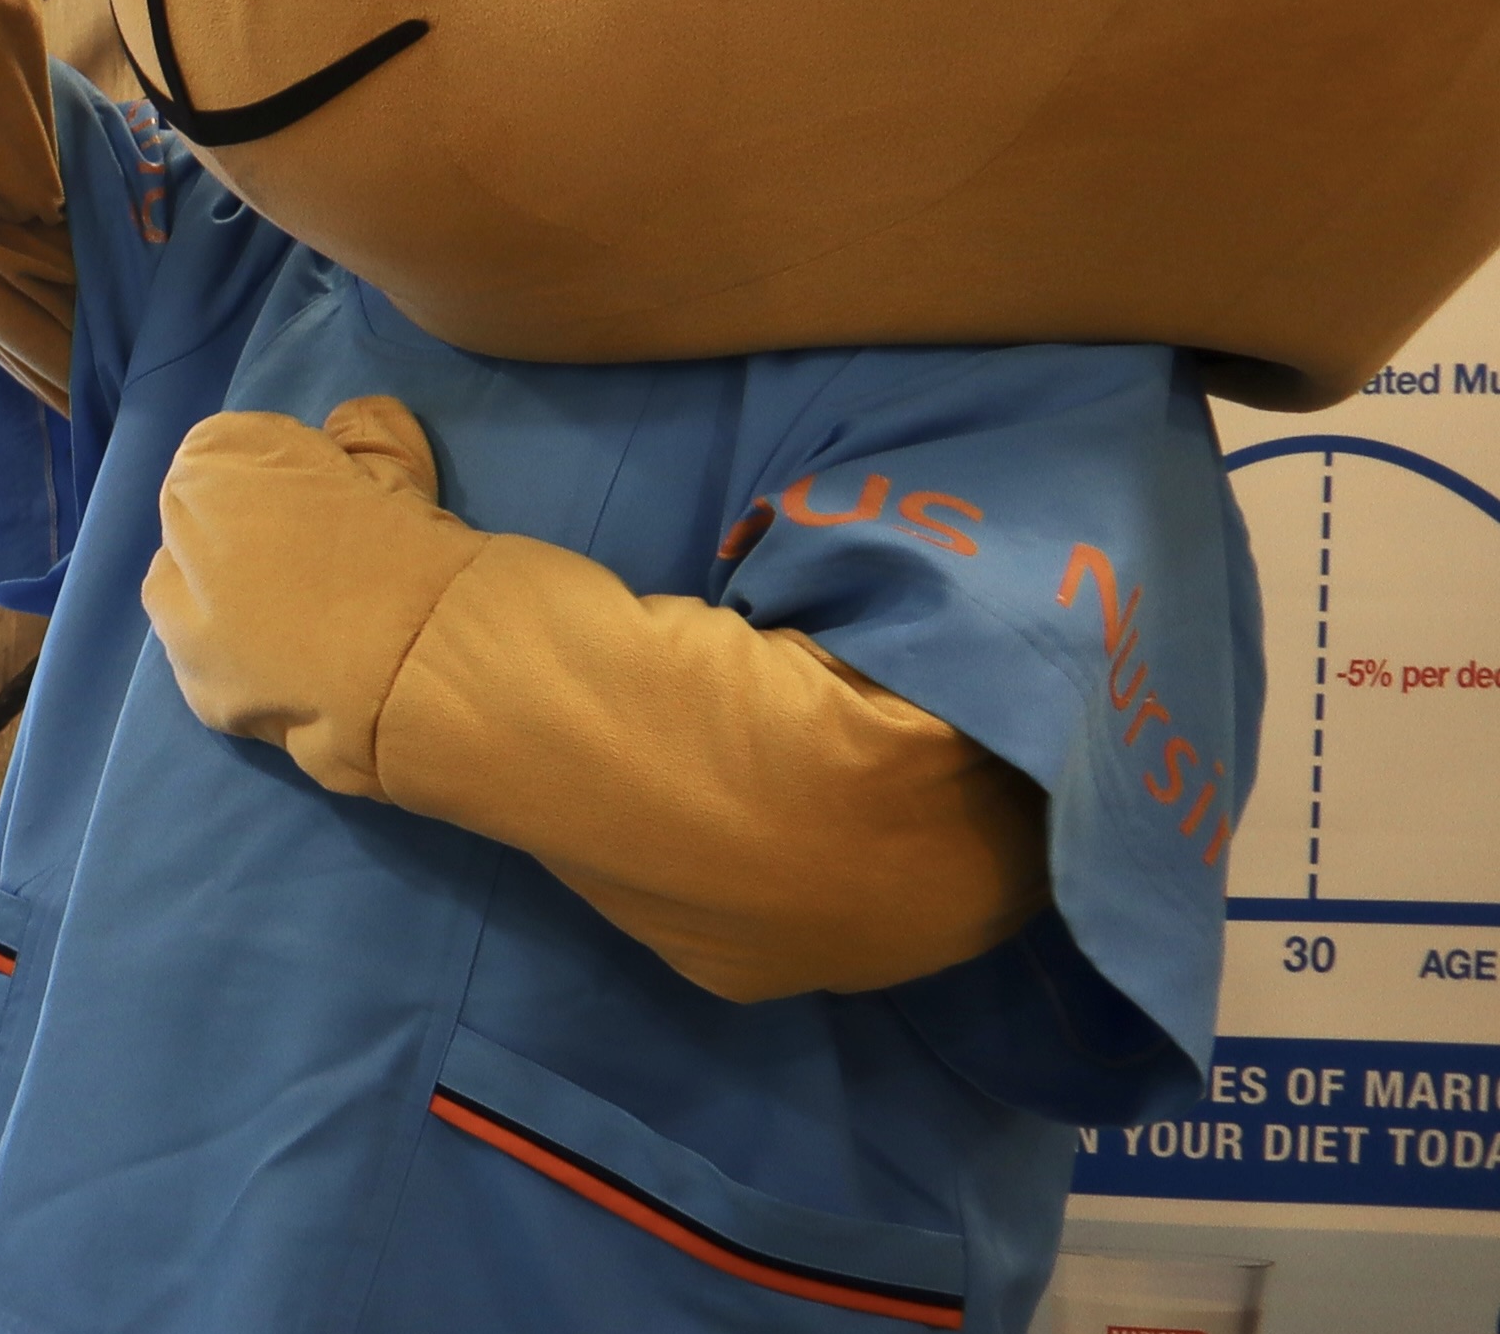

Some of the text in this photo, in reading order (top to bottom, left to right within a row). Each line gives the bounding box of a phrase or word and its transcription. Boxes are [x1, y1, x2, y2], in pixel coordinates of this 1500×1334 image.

[1336, 658, 1393, 689] -5%
[1402, 665, 1450, 694] per
[1283, 935, 1498, 981] 30 AGE
[1286, 1067, 1346, 1107] OF
[1364, 1069, 1500, 1113] MARI
[1123, 1120, 1243, 1161] YOUR
[1263, 1123, 1370, 1164] DIET
